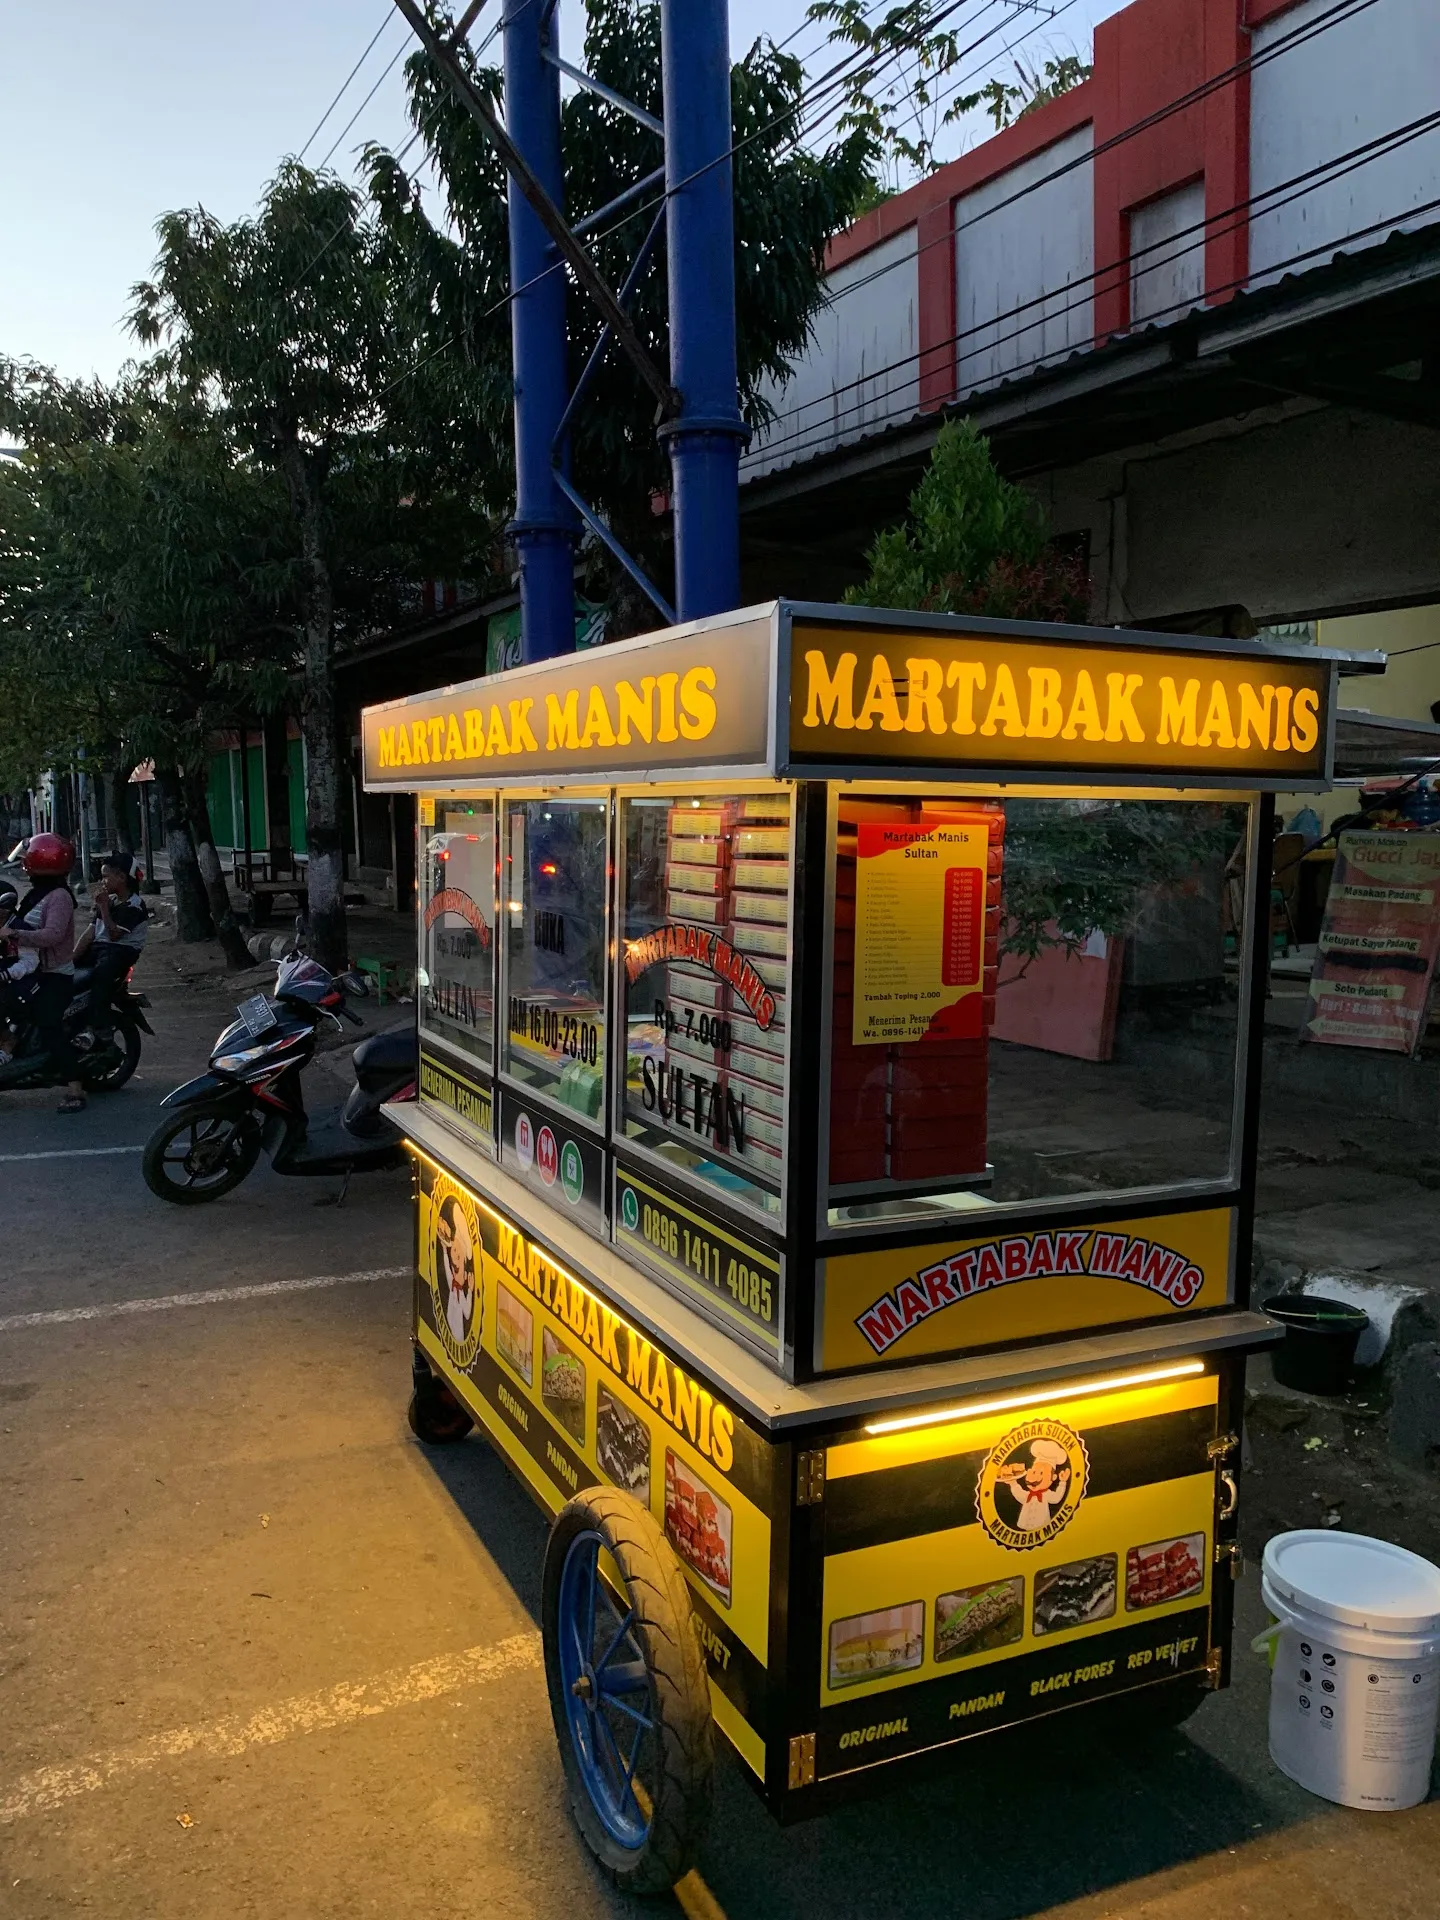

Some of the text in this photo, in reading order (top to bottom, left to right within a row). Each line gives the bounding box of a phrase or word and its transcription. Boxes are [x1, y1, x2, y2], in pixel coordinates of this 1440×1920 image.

[378, 666, 717, 768] MARTABAK MANIS
[803, 650, 1319, 753] MARTABAK MANIS
[883, 831, 969, 843] Martabak Manis
[904, 848, 938, 859] Sultan
[1353, 846, 1403, 863] Gucci
[1344, 886, 1421, 901] Masakan Padang
[1322, 933, 1359, 947] Ketupat
[1386, 939, 1418, 951] Padang
[432, 974, 477, 1028] SULTAN
[713, 936, 776, 1031] MANIS
[864, 991, 941, 1001] Tambah Toping 2.000
[1334, 983, 1388, 998] Soto Padang
[530, 1004, 598, 1068] 16.00-23.00
[655, 998, 678, 1039] Rp.
[684, 1008, 732, 1053] 7.000
[868, 1014, 939, 1026] Menerima Pesan
[245, 1073, 272, 1085] HONDA
[422, 1063, 491, 1133] MENERIMA PESANAN
[642, 1055, 744, 1154] SULTAN
[643, 1204, 772, 1322] 0896 1411 4085
[853, 1229, 1204, 1356] MARTABAK MANIS
[497, 1219, 734, 1472] MARTABAK MANIS
[498, 1383, 529, 1432] ORIGINAL
[546, 1440, 578, 1491] PANDAN
[992, 1423, 1077, 1466] MARTABAK SULTAN
[989, 1503, 1073, 1546] MARTABAK MANIS
[839, 1636, 1199, 1750] ORIGINAL PANDAN BLACK FORES RED VELVET
